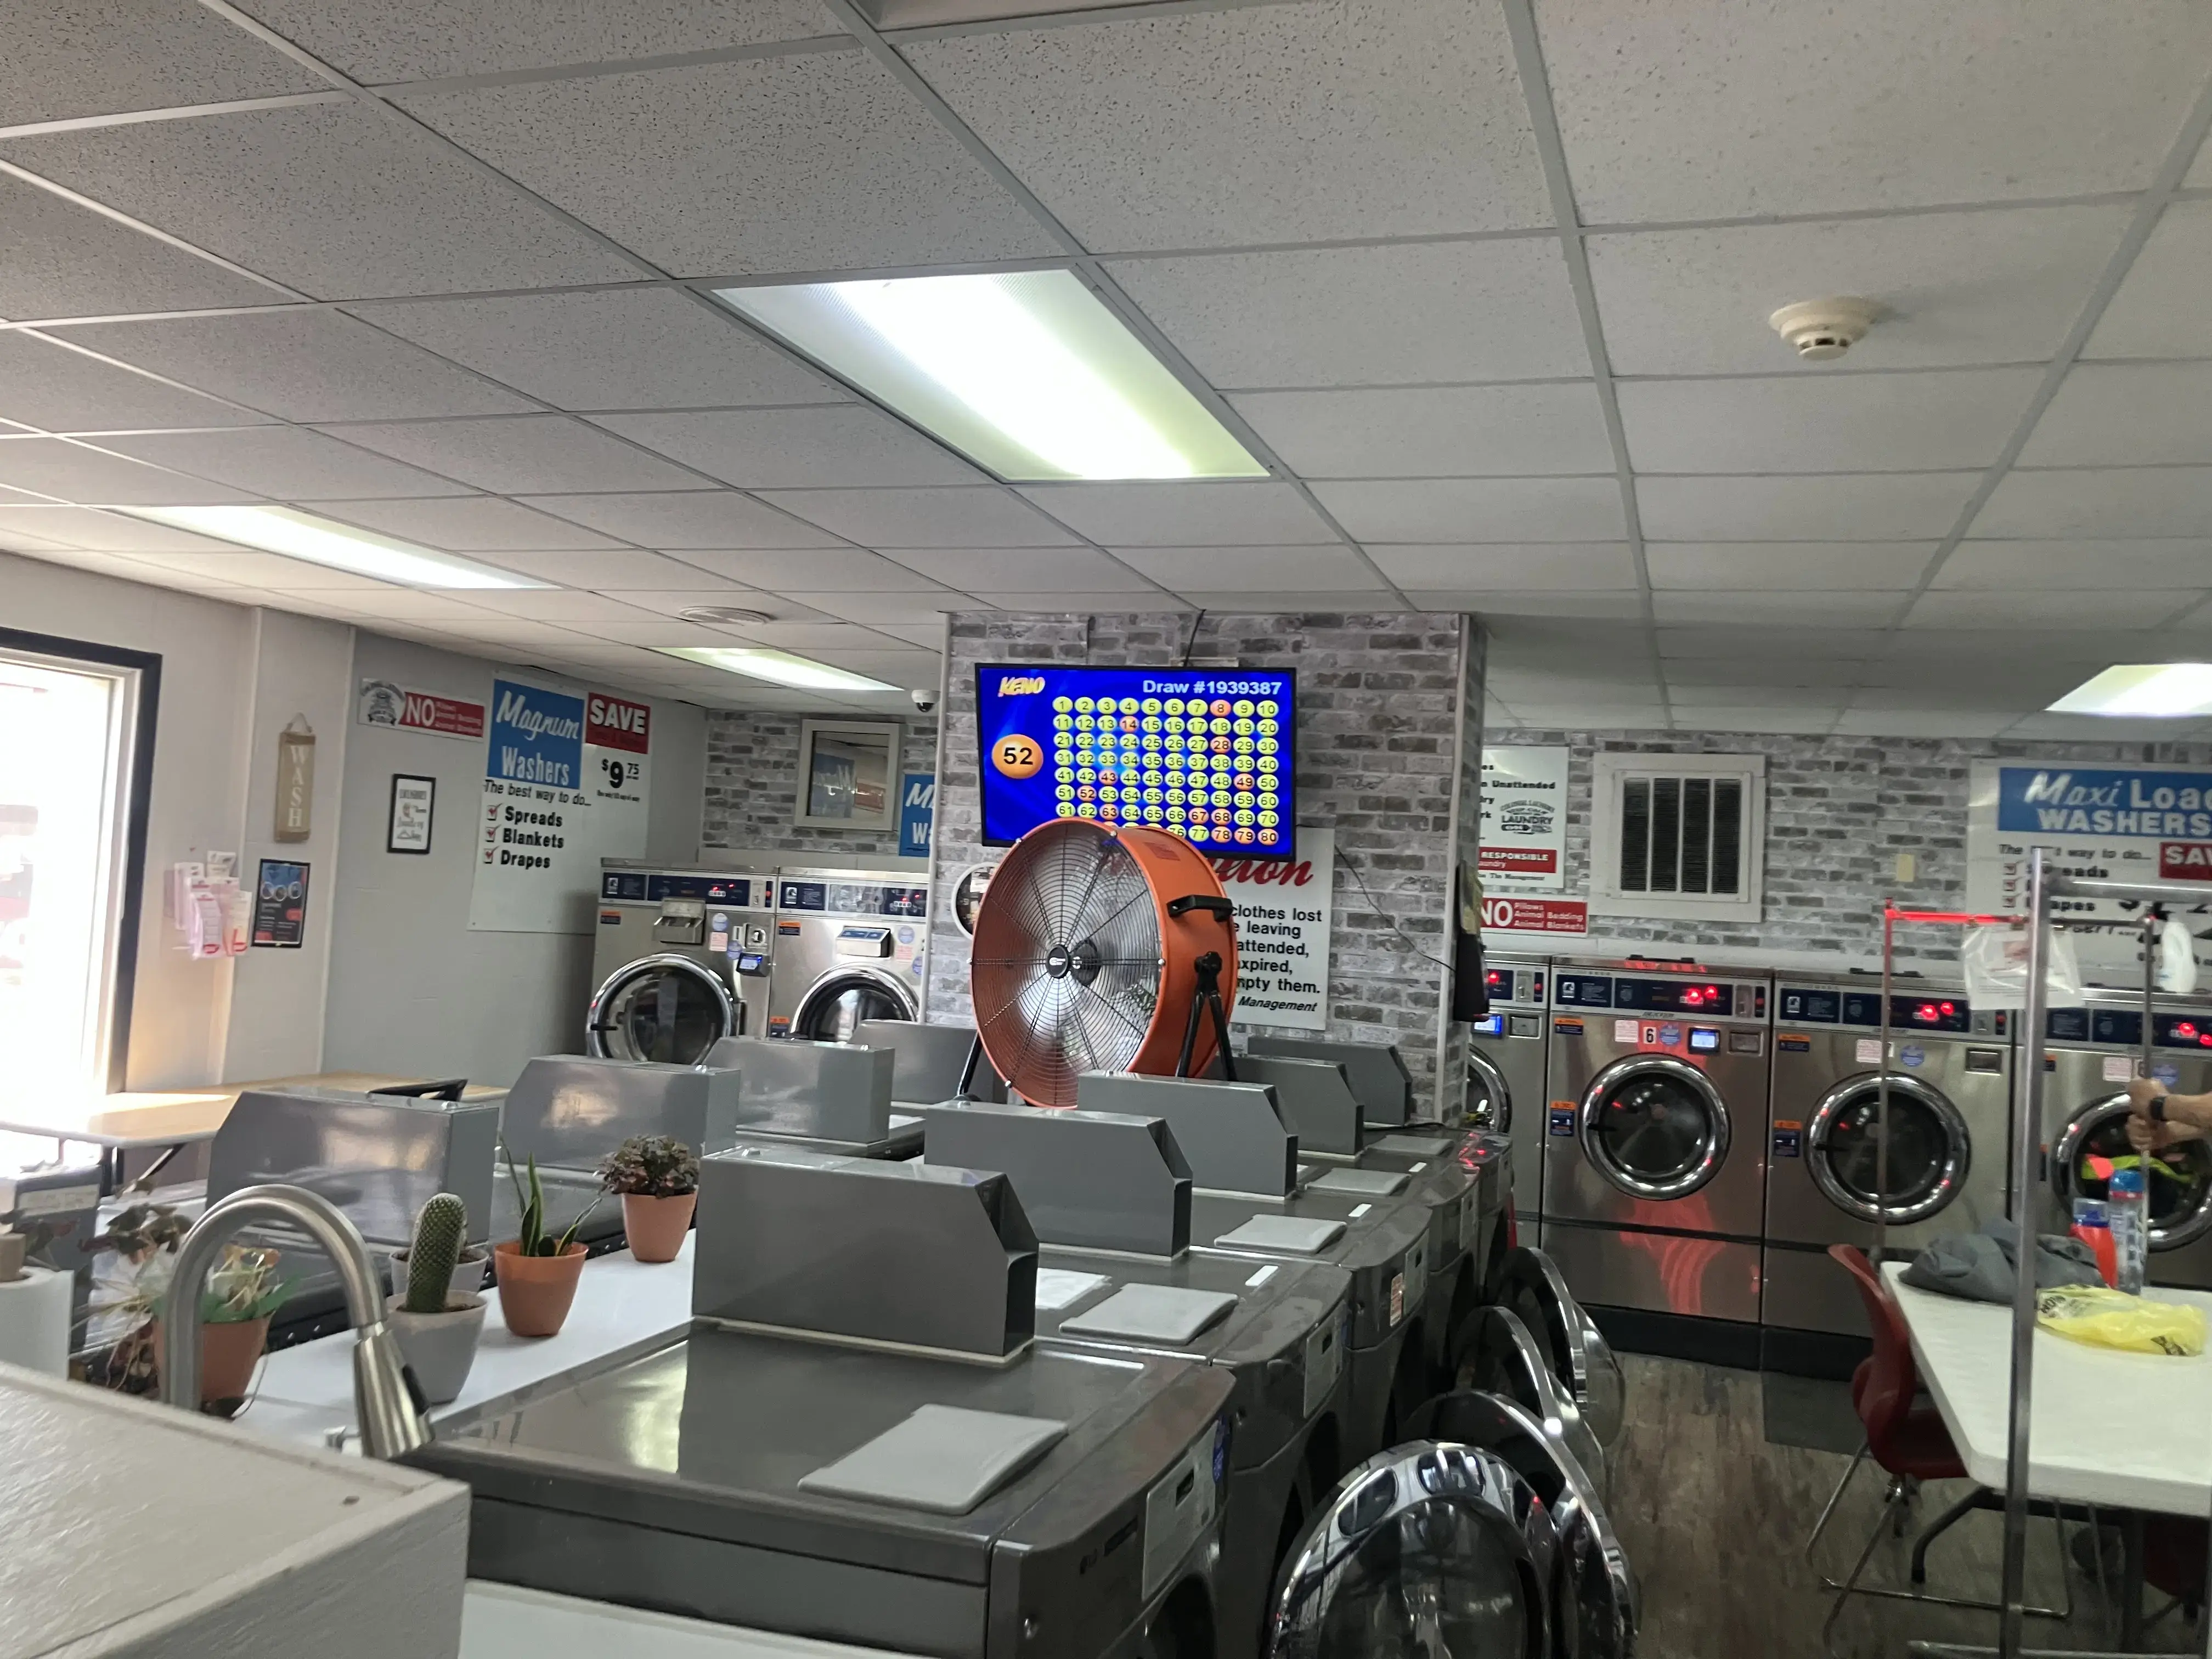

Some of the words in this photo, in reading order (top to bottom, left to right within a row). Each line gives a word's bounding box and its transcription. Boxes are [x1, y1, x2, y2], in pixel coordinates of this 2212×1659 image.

[997, 676, 1046, 697] KENO
[1143, 680, 1189, 693] Draw
[1193, 680, 1283, 695] #1939387
[406, 696, 436, 727] NO
[496, 690, 580, 741] Magnum
[589, 698, 646, 735] SAVE
[1059, 701, 1064, 710] 1
[1081, 701, 1089, 710] 2
[1103, 701, 1111, 710] 3
[1125, 702, 1132, 711] 4
[1148, 702, 1156, 712] 5
[1171, 703, 1178, 712] 6
[1193, 703, 1201, 713] 7
[1217, 703, 1224, 713] 8
[1240, 704, 1248, 713] 9
[1260, 704, 1276, 714] 10
[1056, 718, 1069, 727] 11
[1078, 719, 1092, 729] 12
[1100, 719, 1115, 729] 13
[1122, 720, 1137, 729] 14
[1144, 720, 1160, 730] 15
[1167, 721, 1182, 730] 16
[1190, 721, 1205, 731] 17
[1212, 722, 1228, 732] 18
[1236, 723, 1251, 732] 19
[1260, 723, 1276, 733] 20
[1057, 736, 1070, 745] 21
[1079, 736, 1093, 746] 22
[1101, 737, 1115, 747] 23
[1123, 737, 1138, 747] 24
[1145, 738, 1160, 748] 25
[1167, 739, 1183, 748] 26
[1190, 740, 1206, 749] 27
[1213, 740, 1229, 750] 28
[1237, 741, 1252, 751] 29
[1260, 741, 1276, 752] 30
[1003, 747, 1034, 765] 52
[1057, 753, 1070, 763] 31
[1079, 754, 1093, 764] 32
[1101, 754, 1116, 764] 33
[1123, 755, 1138, 765] 34
[1146, 756, 1161, 766] 35
[1168, 757, 1183, 766] 36
[1190, 758, 1206, 767] 37
[1214, 758, 1229, 768] 38
[1237, 759, 1252, 769] 39
[1260, 760, 1276, 770] 40
[501, 745, 570, 786] Washers
[287, 744, 310, 827] WASH
[1057, 771, 1071, 780] 41
[1079, 772, 1094, 781] 42
[1101, 772, 1116, 782] 43
[1123, 774, 1138, 782] 44
[1145, 774, 1161, 783] 45
[1167, 775, 1183, 785] 46
[1190, 776, 1206, 785] 47
[1214, 776, 1229, 786] 48
[1237, 777, 1252, 787] 49
[1261, 778, 1276, 788] 50
[483, 779, 504, 794] The
[507, 783, 532, 798] best
[535, 790, 556, 804] way
[558, 791, 570, 803] to
[1058, 788, 1071, 798] 51
[1080, 789, 1095, 798] 52
[1102, 789, 1116, 799] 53
[1124, 791, 1139, 800] 54
[1146, 792, 1161, 801] 55
[1169, 792, 1184, 802] 56
[1191, 793, 1206, 803] 57
[1214, 794, 1229, 804] 58
[1238, 795, 1253, 805] 59
[1261, 796, 1276, 806] 60
[2023, 770, 2124, 808] Maxi
[504, 805, 563, 827] Spreads
[1059, 805, 1072, 815] 61
[1080, 806, 1095, 816] 62
[1102, 808, 1118, 817] 63
[1124, 808, 1139, 817] 64
[1147, 809, 1162, 819] 65
[1169, 810, 1184, 820] 66
[1191, 811, 1206, 821] 67
[1214, 812, 1230, 822] 68
[1238, 813, 1253, 823] 69
[1261, 814, 1277, 824] 70
[2036, 807, 2211, 837] WASHERS
[502, 827, 565, 849] Blankets
[1192, 828, 1207, 838] 77
[1214, 830, 1230, 840] 78
[1237, 831, 1254, 841] 79
[1261, 832, 1277, 842] 80
[500, 849, 551, 870] Drapes
[1293, 907, 1322, 922] lost
[1481, 900, 1514, 927] NO
[1247, 921, 1301, 939] leaving
[1237, 939, 1310, 958] attended,
[1237, 958, 1293, 975] xpired,
[1277, 978, 1321, 994] them.
[1238, 996, 1318, 1012] Management
[1646, 1028, 1654, 1043] 6
